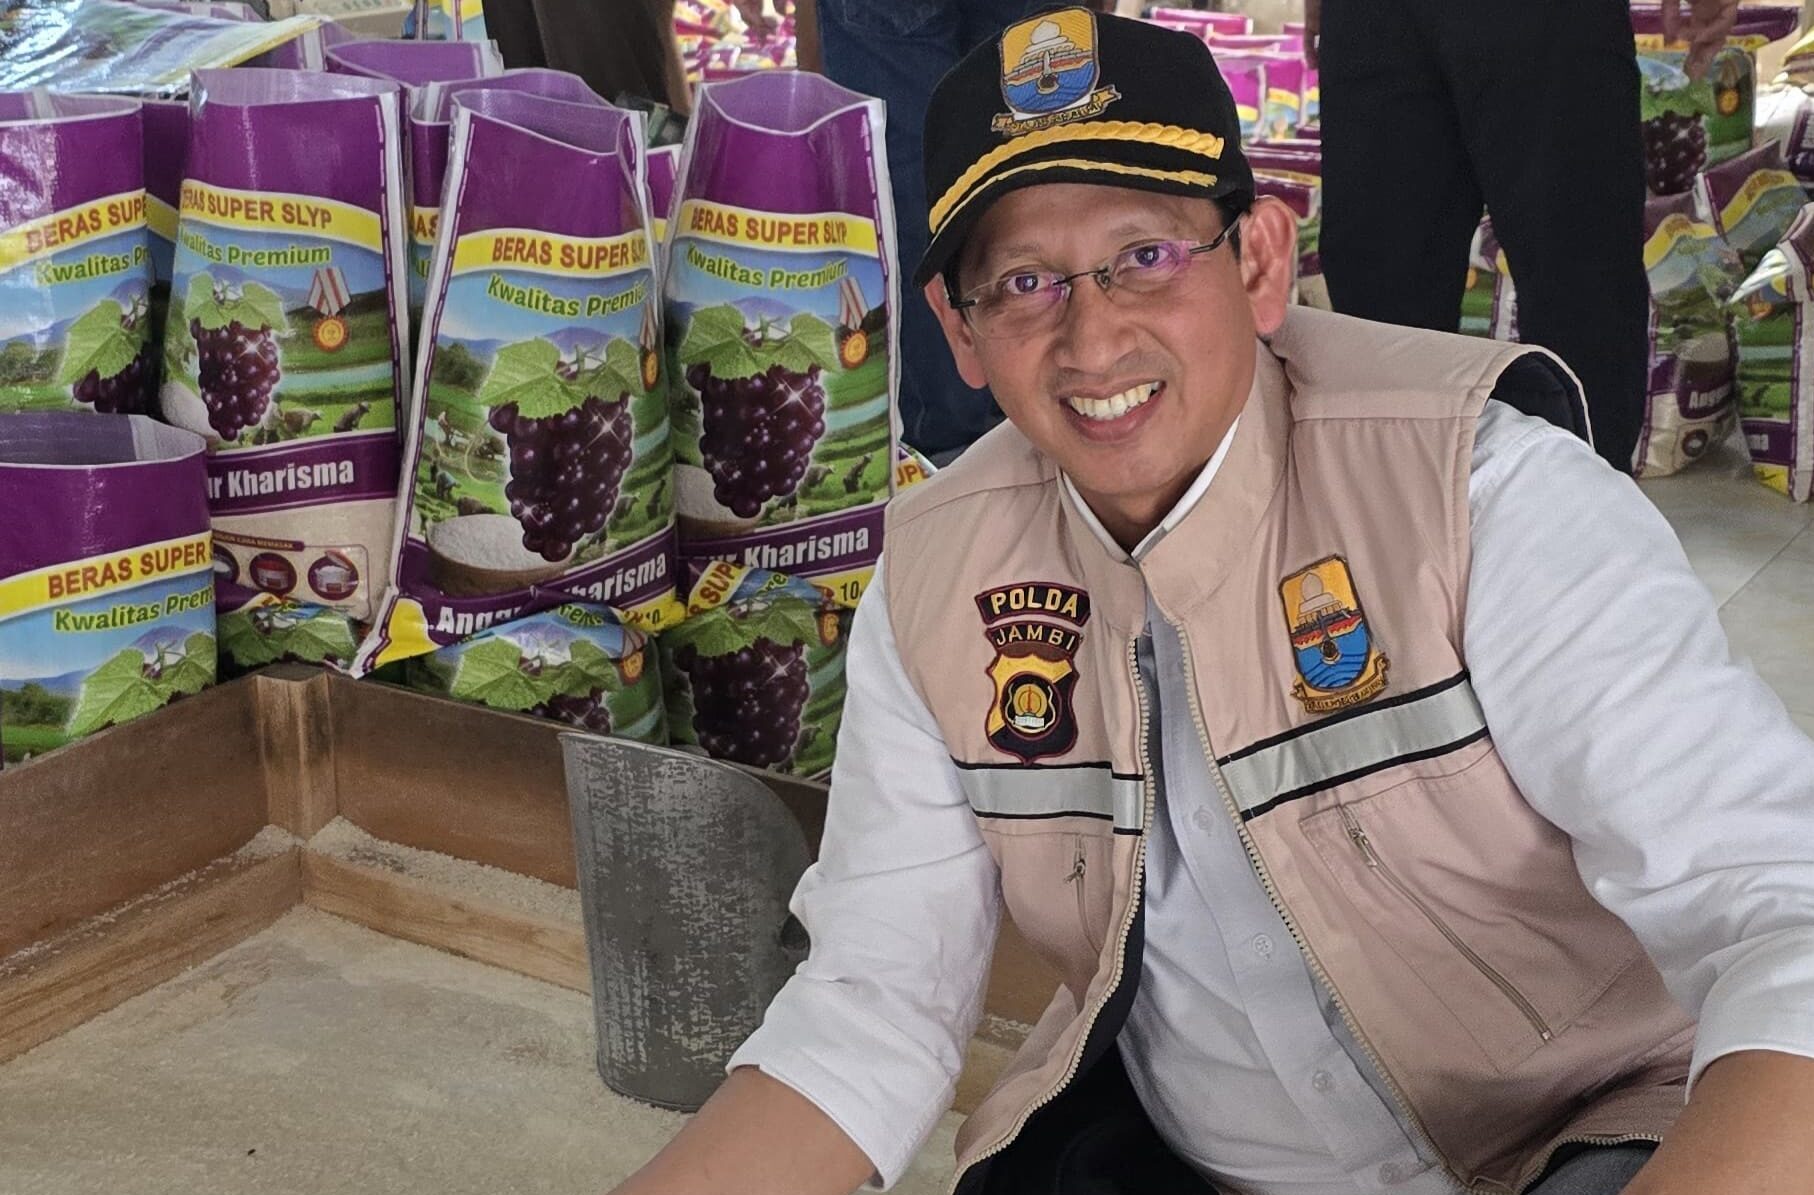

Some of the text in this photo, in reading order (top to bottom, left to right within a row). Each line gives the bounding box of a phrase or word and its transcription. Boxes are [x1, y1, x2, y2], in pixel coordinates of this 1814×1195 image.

[207, 193, 275, 222] SUPER
[281, 202, 332, 229] SLYP
[691, 207, 739, 238] BERAS
[745, 217, 819, 245] SUPER
[26, 208, 102, 253] BERAS
[37, 254, 130, 284] Kwalitas
[228, 245, 331, 265] Premium
[492, 237, 553, 265] BERAS
[560, 243, 629, 269] SUPER
[687, 243, 763, 286] Kwalitas
[488, 274, 579, 317] Kwalitas
[227, 460, 354, 498] Kharisma
[743, 527, 869, 569] Kharisma
[48, 557, 133, 599] BERAS
[140, 541, 206, 576] SUPER
[55, 604, 160, 632] Kwalitas
[990, 586, 1078, 619] POLDA
[996, 624, 1076, 650] JAMBI
